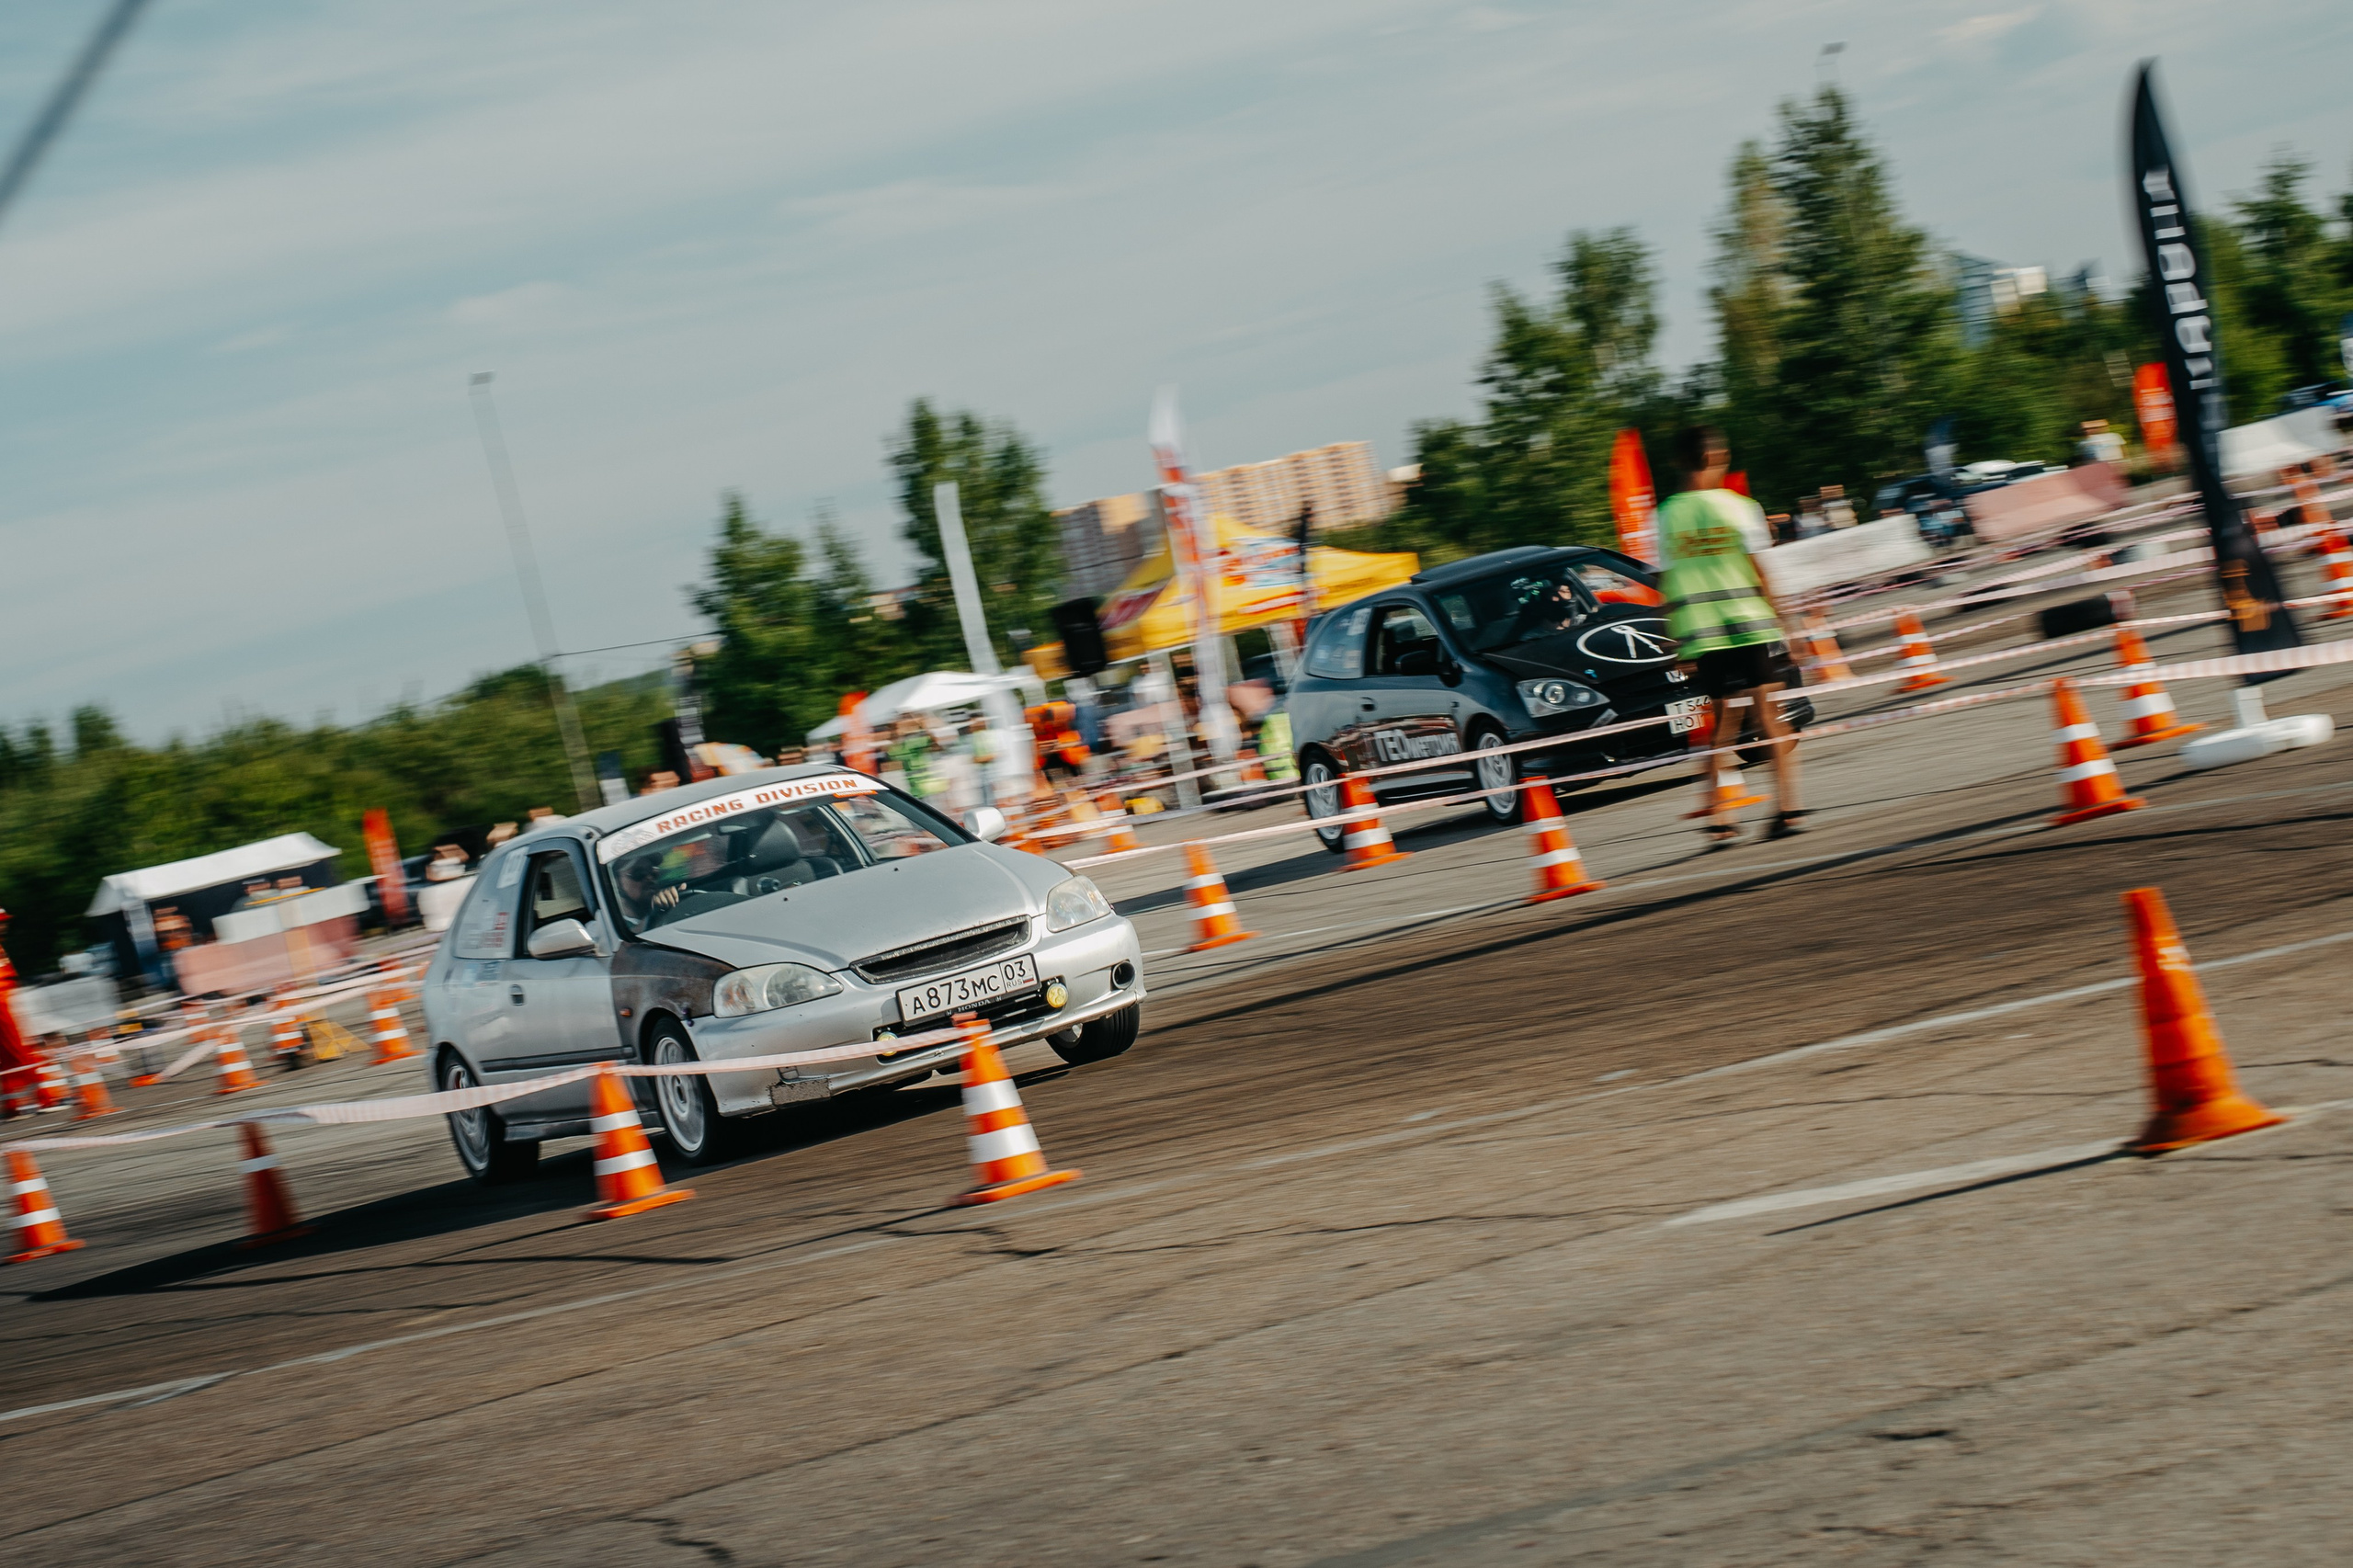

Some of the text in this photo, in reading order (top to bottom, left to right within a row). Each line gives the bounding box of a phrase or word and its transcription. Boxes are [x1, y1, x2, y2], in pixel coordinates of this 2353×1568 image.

[656, 778, 858, 834] RACING DIVISION
[1004, 960, 1026, 981] 03
[1006, 980, 1023, 988] RUS
[958, 999, 991, 1012] HONDA
